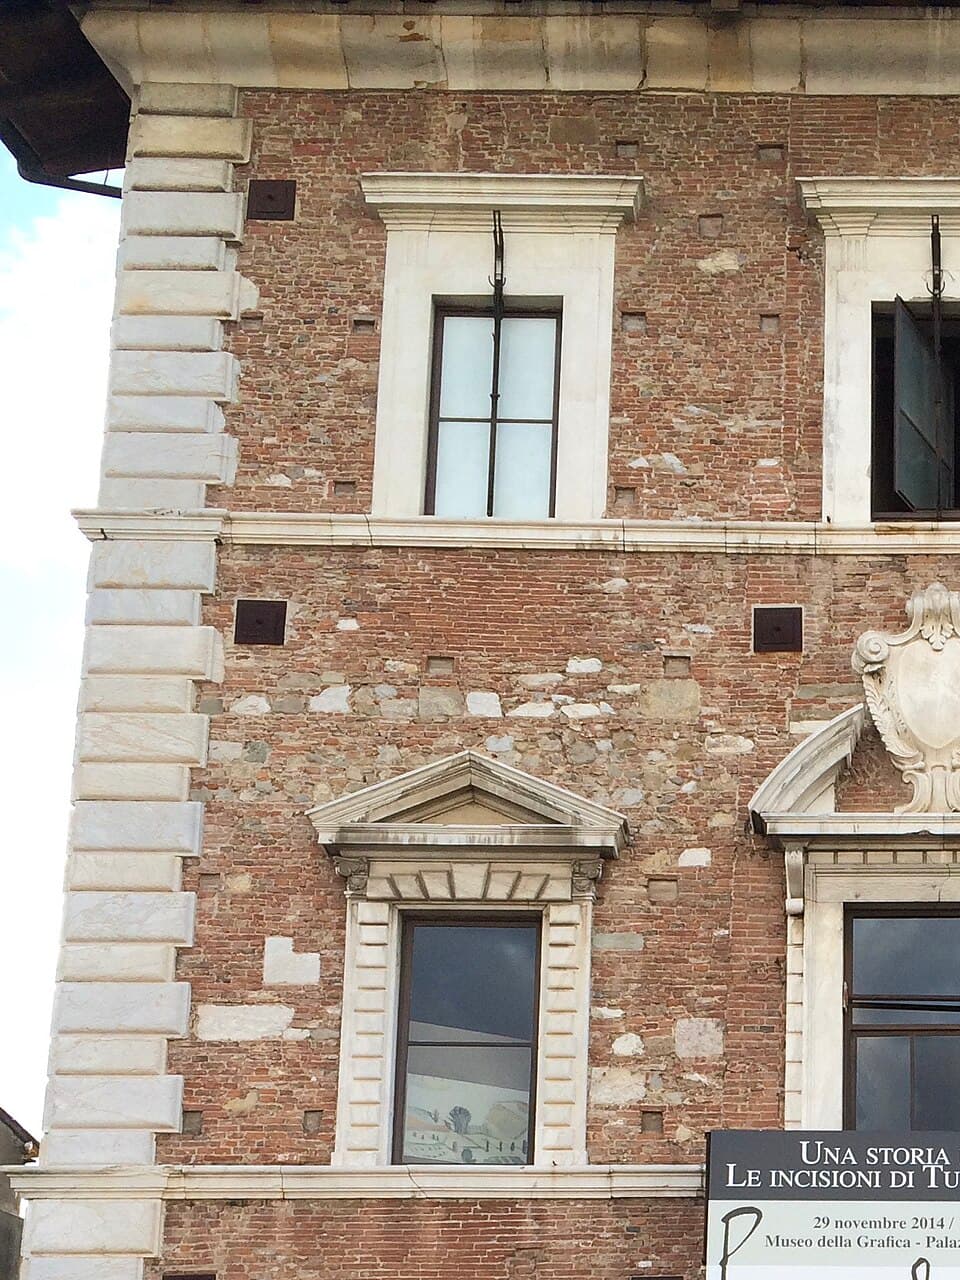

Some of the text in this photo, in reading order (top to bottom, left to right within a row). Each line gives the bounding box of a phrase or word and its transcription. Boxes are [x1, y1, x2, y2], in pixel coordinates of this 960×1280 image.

[800, 1141, 857, 1165] UNA
[866, 1148, 951, 1165] STORIA
[726, 1164, 761, 1187] LE
[769, 1170, 881, 1188] INCISIONI
[889, 1171, 914, 1188] DI
[813, 1216, 830, 1229] 29
[834, 1217, 907, 1229] novembre
[911, 1217, 945, 1230] 2014
[949, 1217, 954, 1230] /
[765, 1235, 813, 1247] Museo
[817, 1235, 851, 1248] della
[857, 1235, 911, 1248] Grafica
